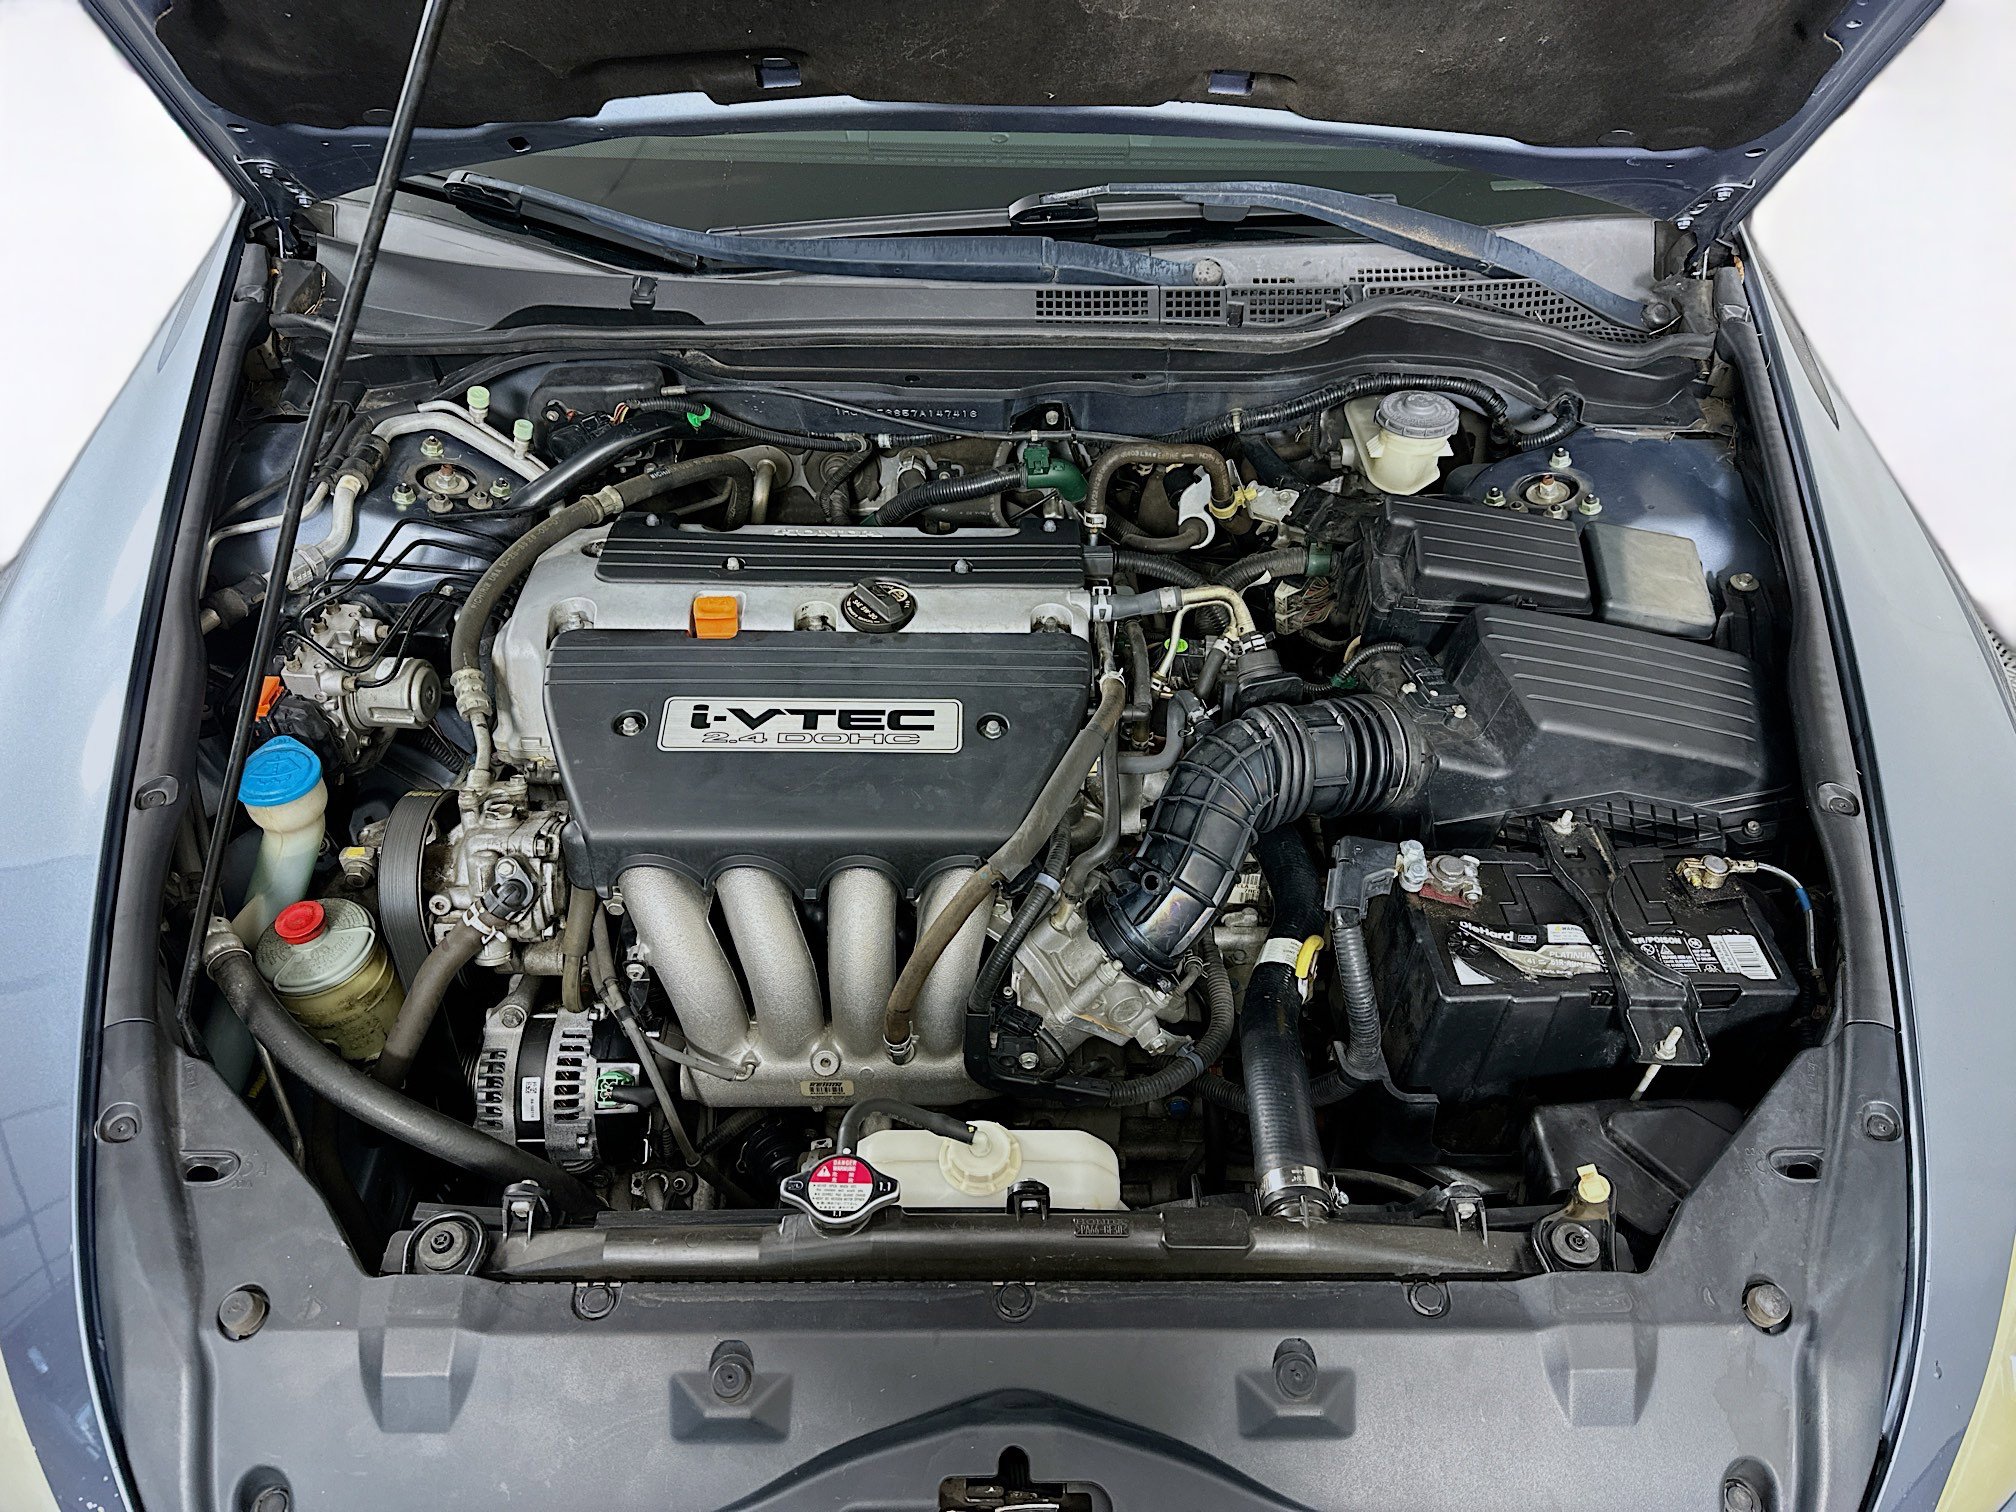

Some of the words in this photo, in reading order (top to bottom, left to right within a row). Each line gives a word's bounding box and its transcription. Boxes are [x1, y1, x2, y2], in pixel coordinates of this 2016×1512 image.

[690, 703, 936, 731] i-VTEC
[701, 732, 768, 744] 2.4
[777, 732, 921, 745] DOHC
[1459, 920, 1515, 942] DieHard
[1550, 951, 1596, 960] PLATINUM
[879, 1181, 891, 1192] 1.1
